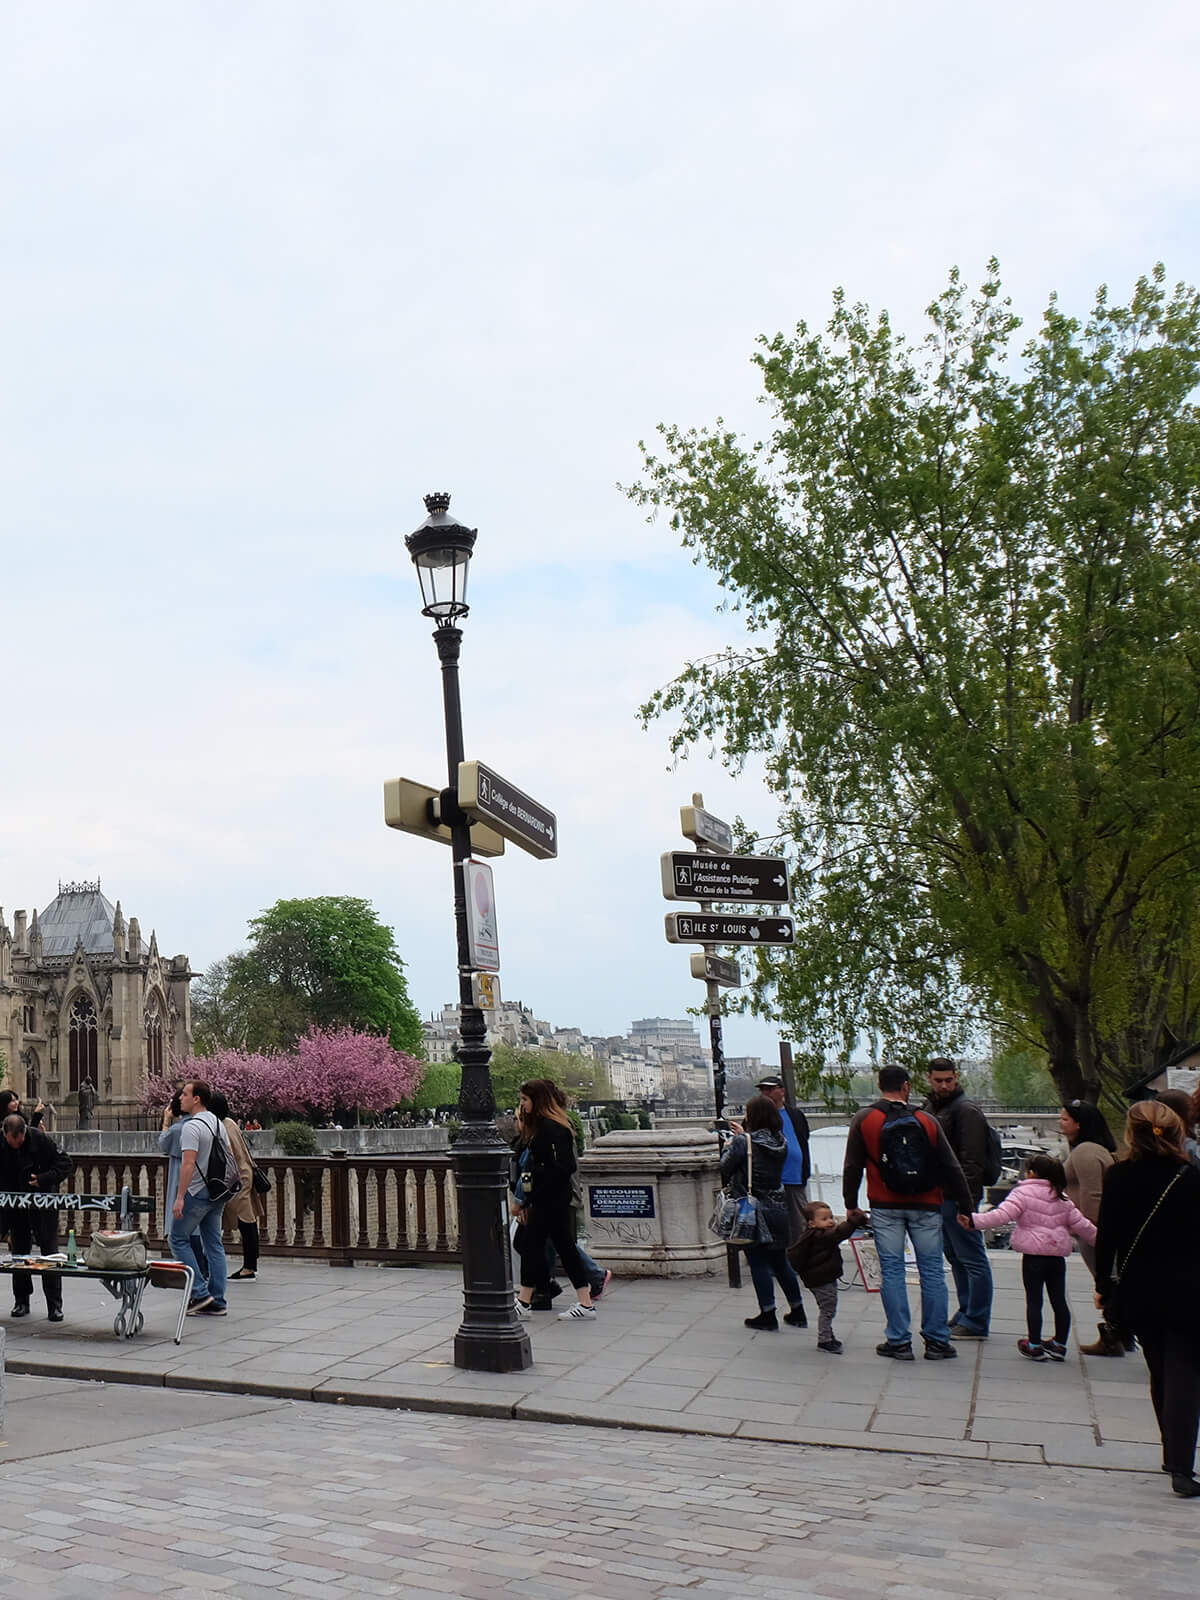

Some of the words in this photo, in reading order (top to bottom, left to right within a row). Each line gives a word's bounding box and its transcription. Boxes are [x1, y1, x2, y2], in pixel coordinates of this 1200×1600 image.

[692, 860, 718, 870] Musée
[720, 862, 731, 871] de
[732, 874, 760, 887] Publique
[694, 923, 707, 933] ILE
[723, 924, 747, 934] LOUIS
